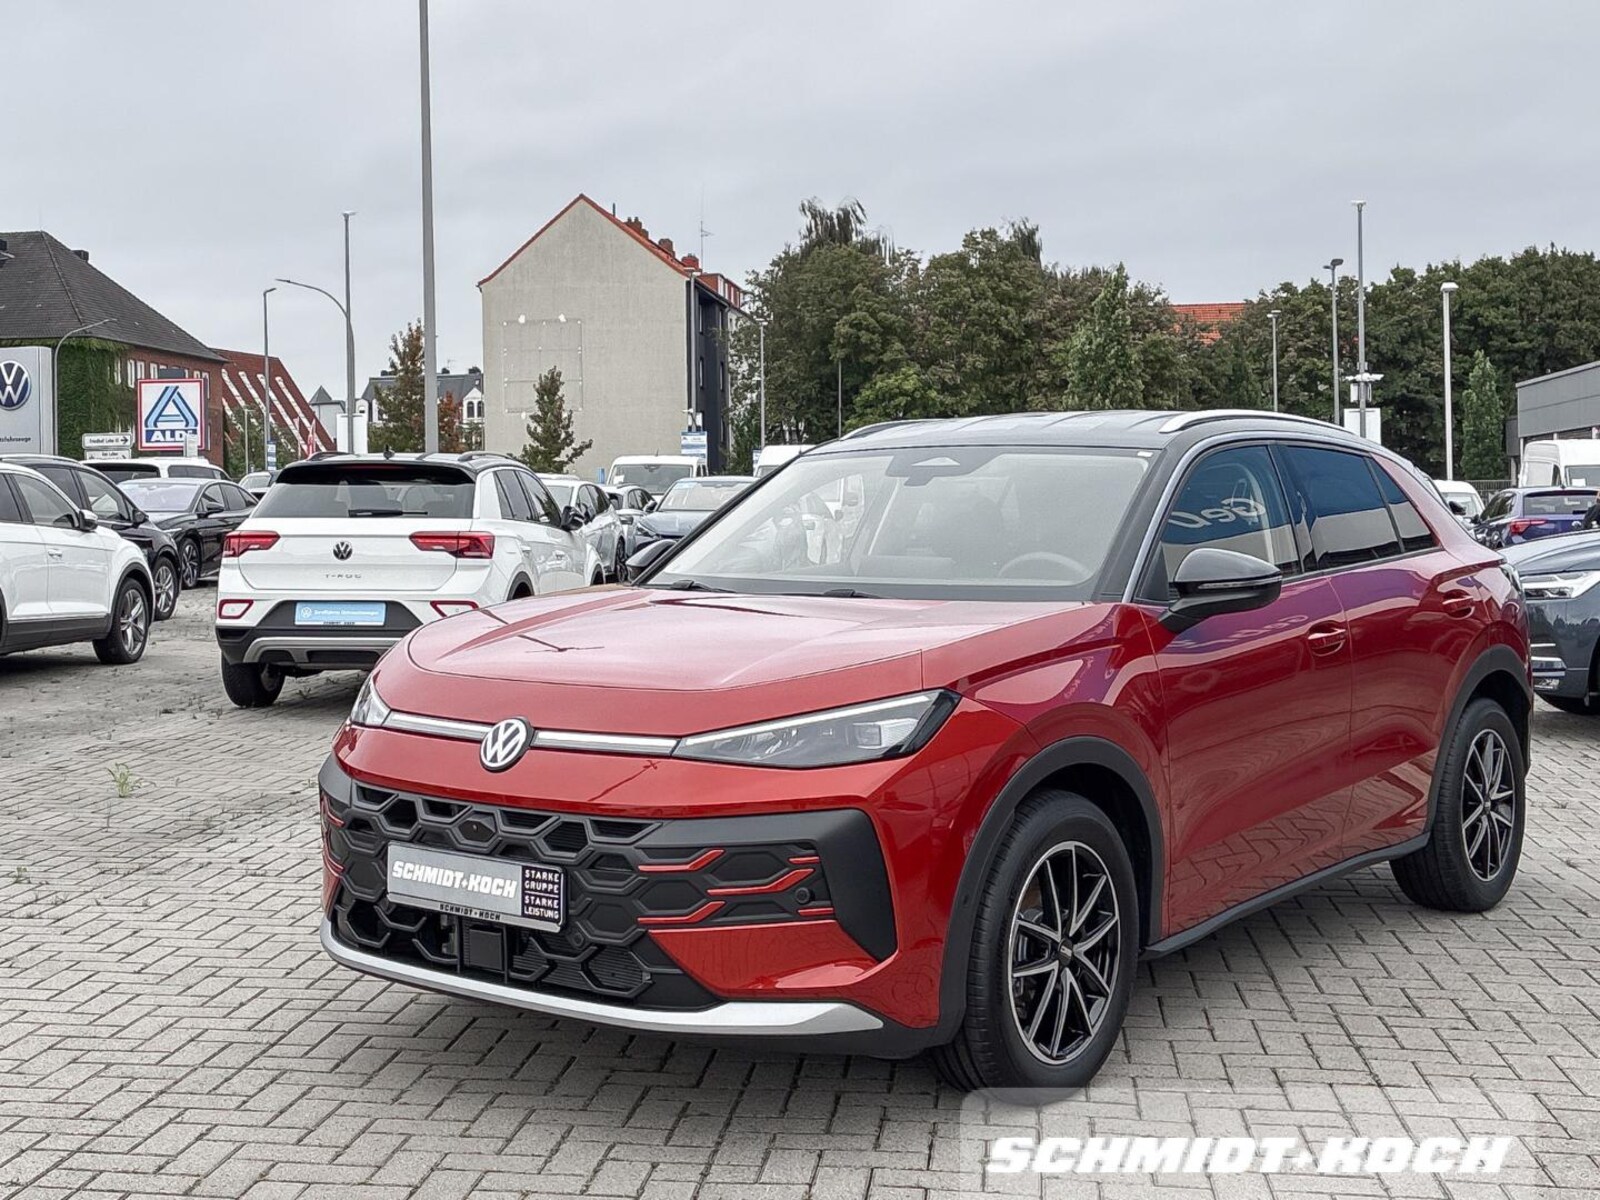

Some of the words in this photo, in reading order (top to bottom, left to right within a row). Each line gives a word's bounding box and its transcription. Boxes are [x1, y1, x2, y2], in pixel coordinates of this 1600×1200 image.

[150, 429, 193, 442] ALD
[524, 869, 560, 883] STARKE
[524, 880, 559, 894] GRUPPE
[524, 895, 559, 909] STARKE
[523, 905, 559, 920] LEISTUNG
